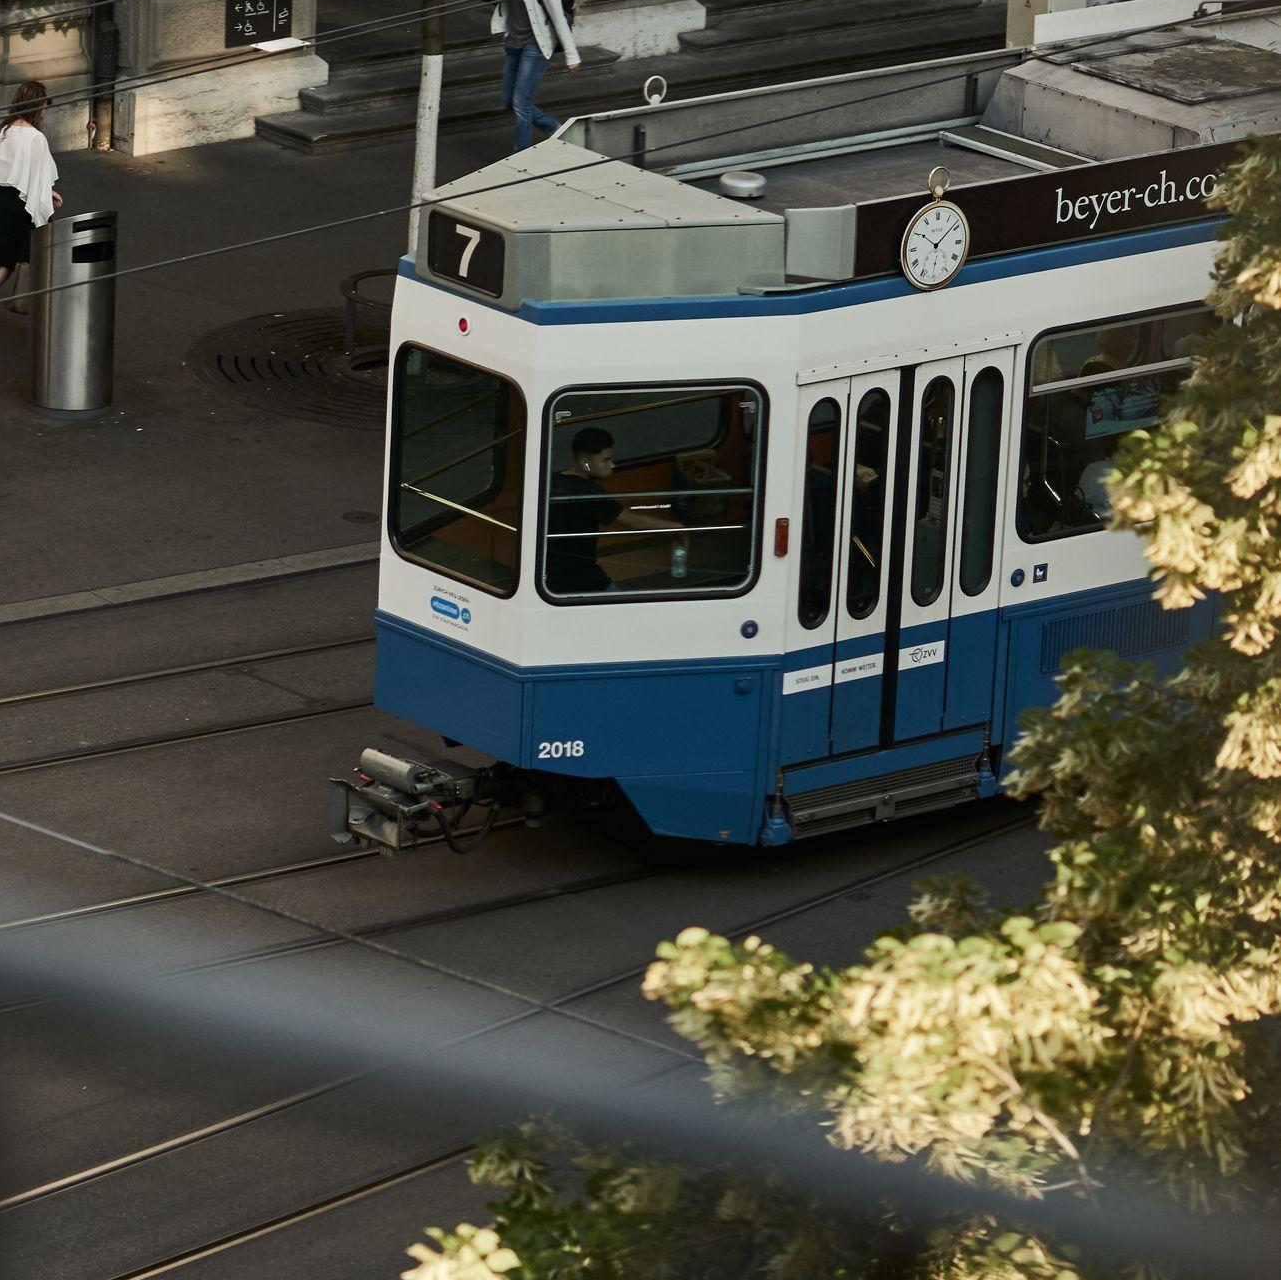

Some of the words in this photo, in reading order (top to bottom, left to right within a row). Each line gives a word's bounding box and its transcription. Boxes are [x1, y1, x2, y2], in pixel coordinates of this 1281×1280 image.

[456, 224, 481, 278] 7
[923, 648, 938, 659] ZVV
[538, 740, 585, 759] 2018
